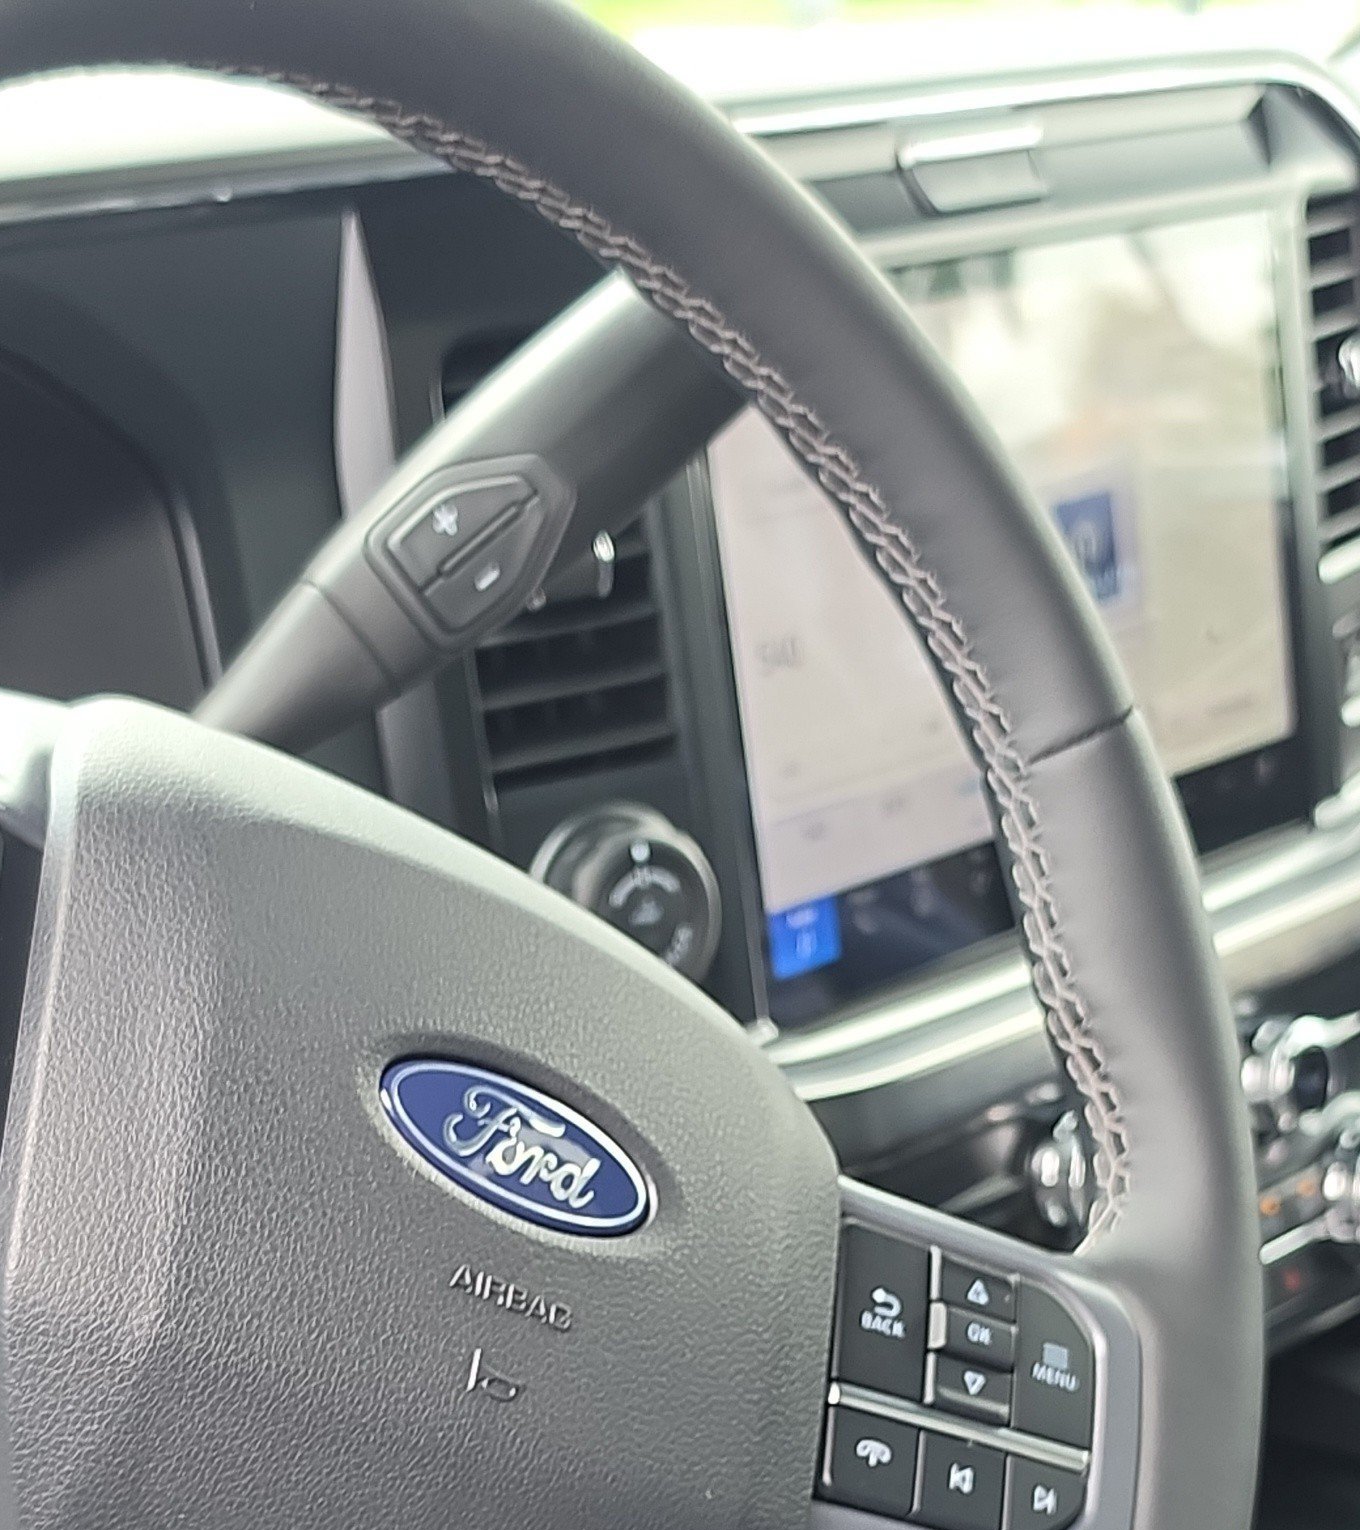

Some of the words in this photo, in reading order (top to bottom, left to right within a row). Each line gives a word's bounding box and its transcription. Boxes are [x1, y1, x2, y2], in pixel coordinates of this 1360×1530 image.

[443, 1085, 601, 1208] Ford
[449, 1263, 574, 1332] AIRBAG
[860, 1309, 906, 1339] BACK
[966, 1322, 992, 1345] OK
[1031, 1360, 1080, 1392] MENU
